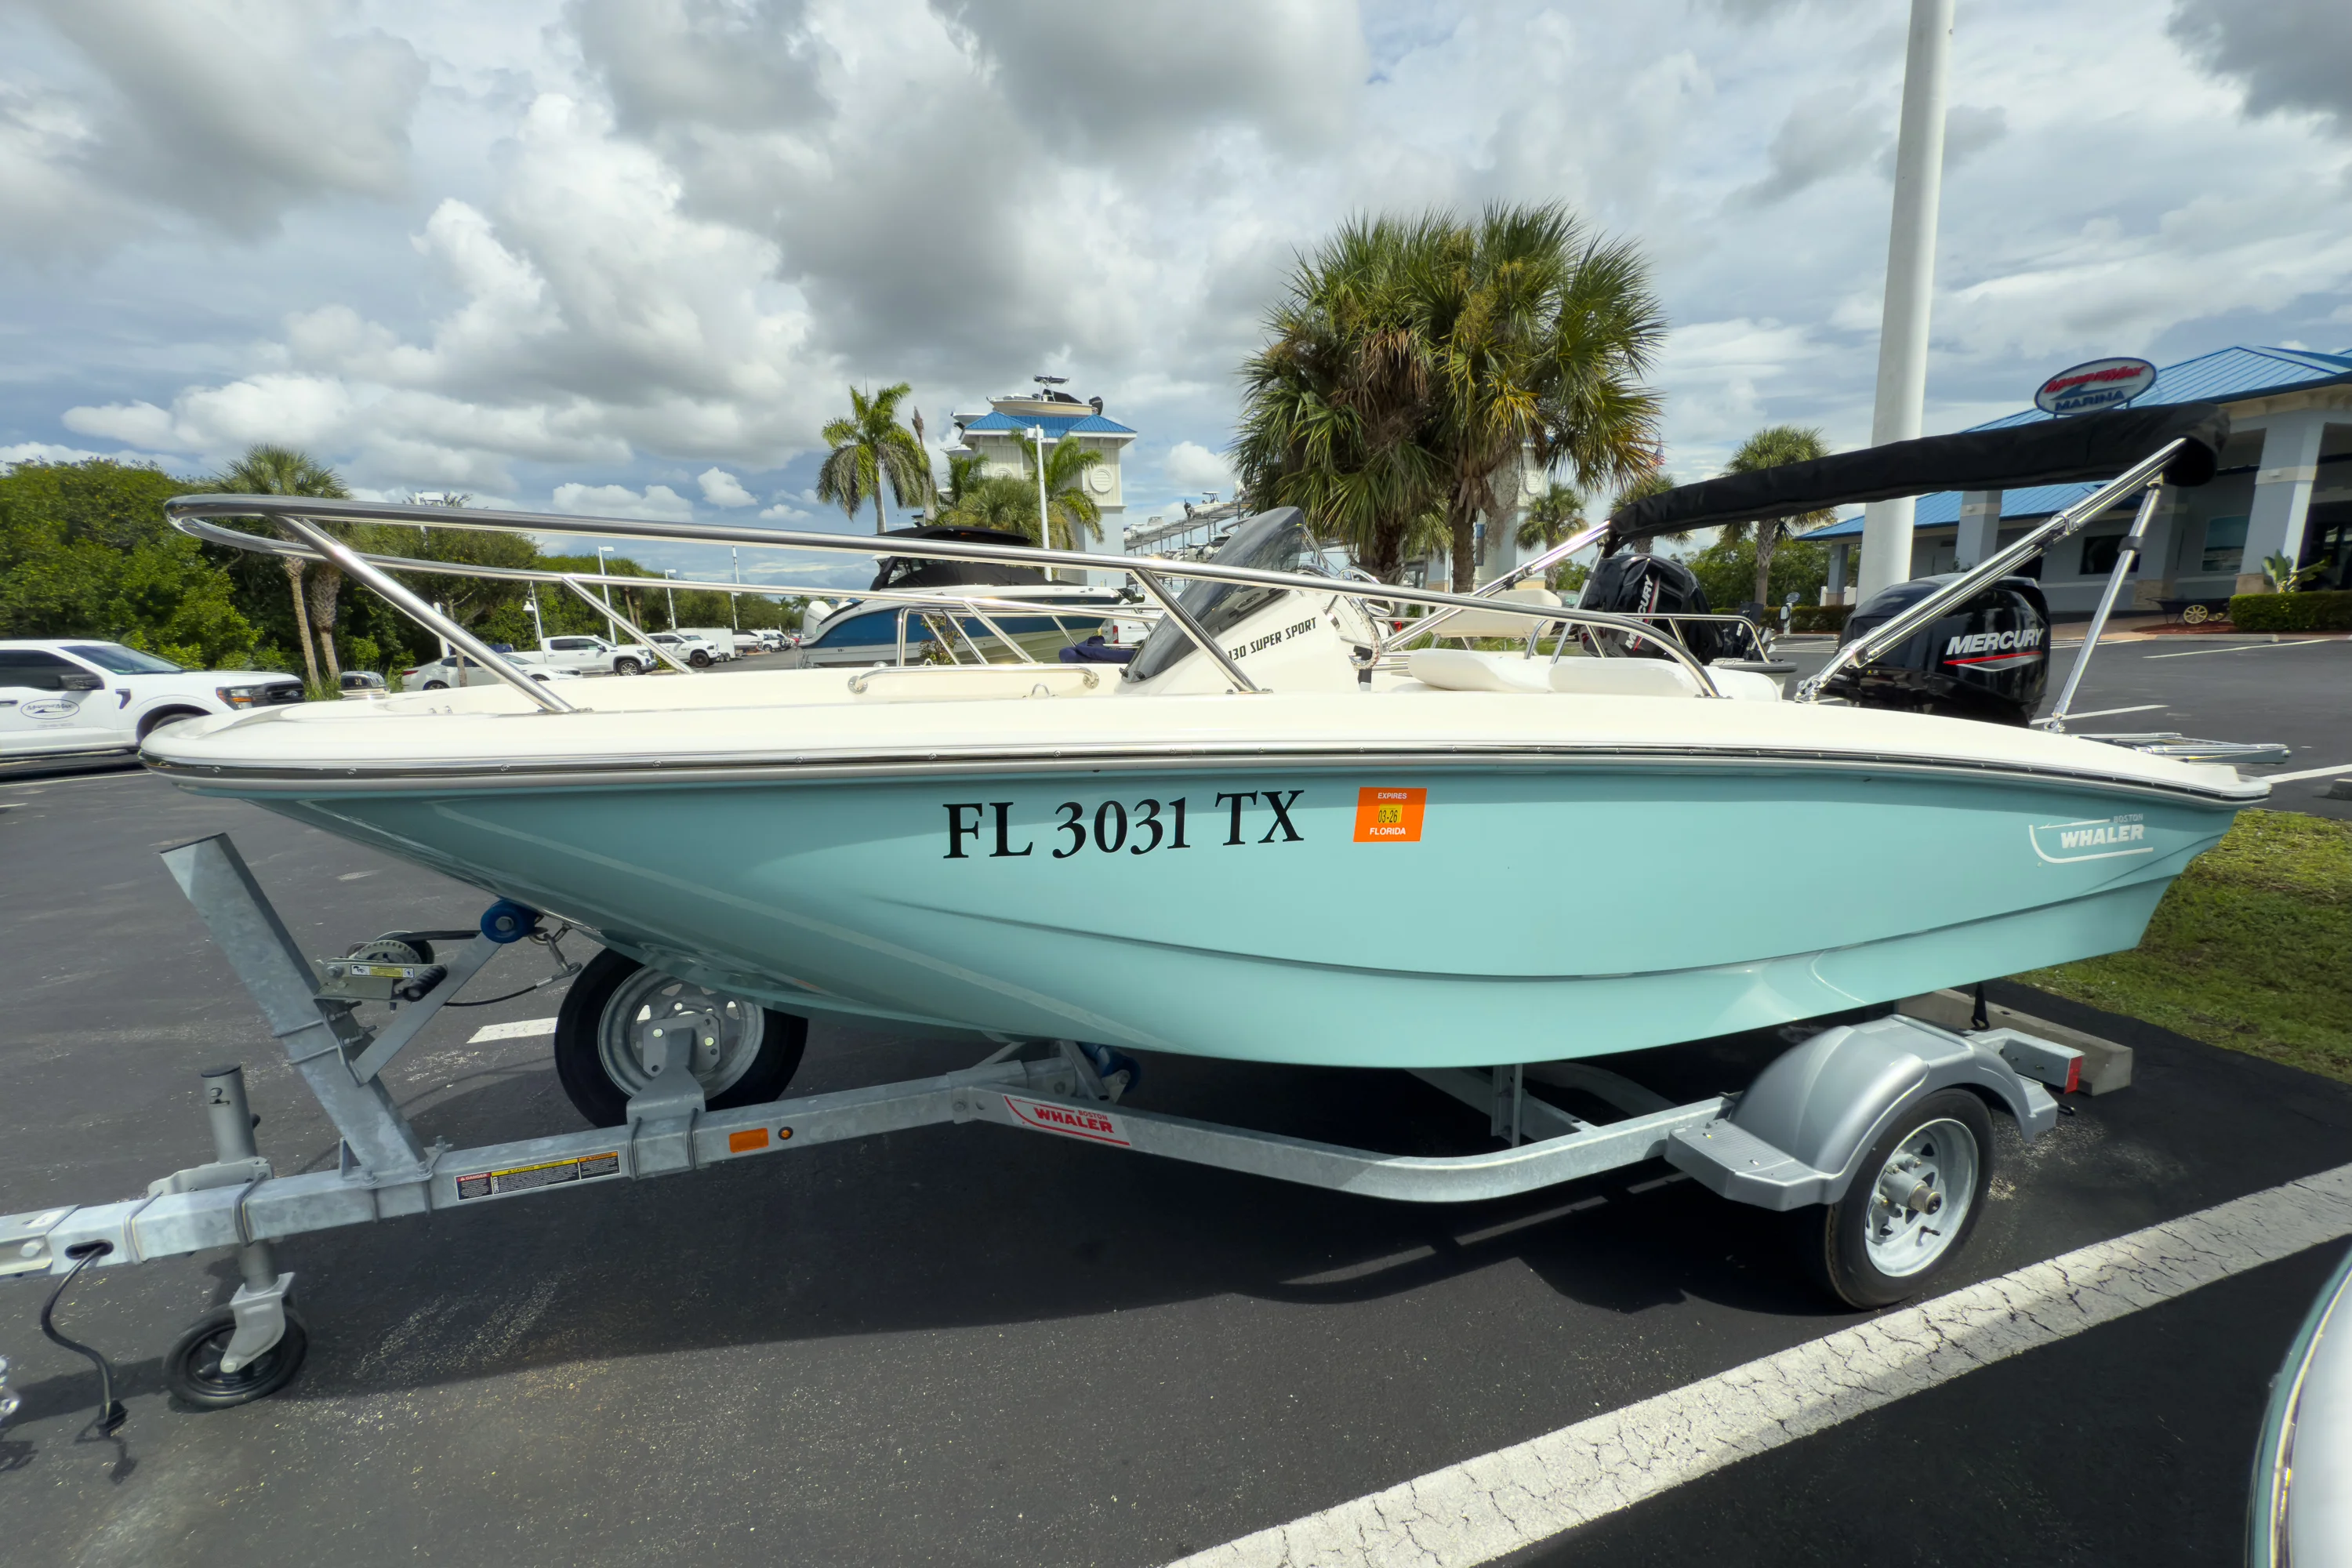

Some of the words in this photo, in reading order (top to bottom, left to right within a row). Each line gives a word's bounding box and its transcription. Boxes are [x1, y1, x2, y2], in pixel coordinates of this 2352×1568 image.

[2054, 390, 2125, 412] MARINA
[1624, 574, 1653, 650] MCURY
[1228, 644, 1247, 661] 130
[1250, 630, 1282, 654] SUPER
[1285, 616, 1316, 641] SPORT
[1945, 628, 2045, 655] MERCURY
[942, 801, 1034, 859] FL
[1051, 797, 1191, 859] 3031
[1214, 789, 1305, 846] TX
[1377, 809, 1398, 823] 03-26
[2113, 813, 2143, 823] BOSTON
[1369, 827, 1406, 836] FLORIDA
[2060, 824, 2145, 849] WHALER
[1033, 1106, 1115, 1134] WHALER
[1077, 1109, 1109, 1121] BOSTON
